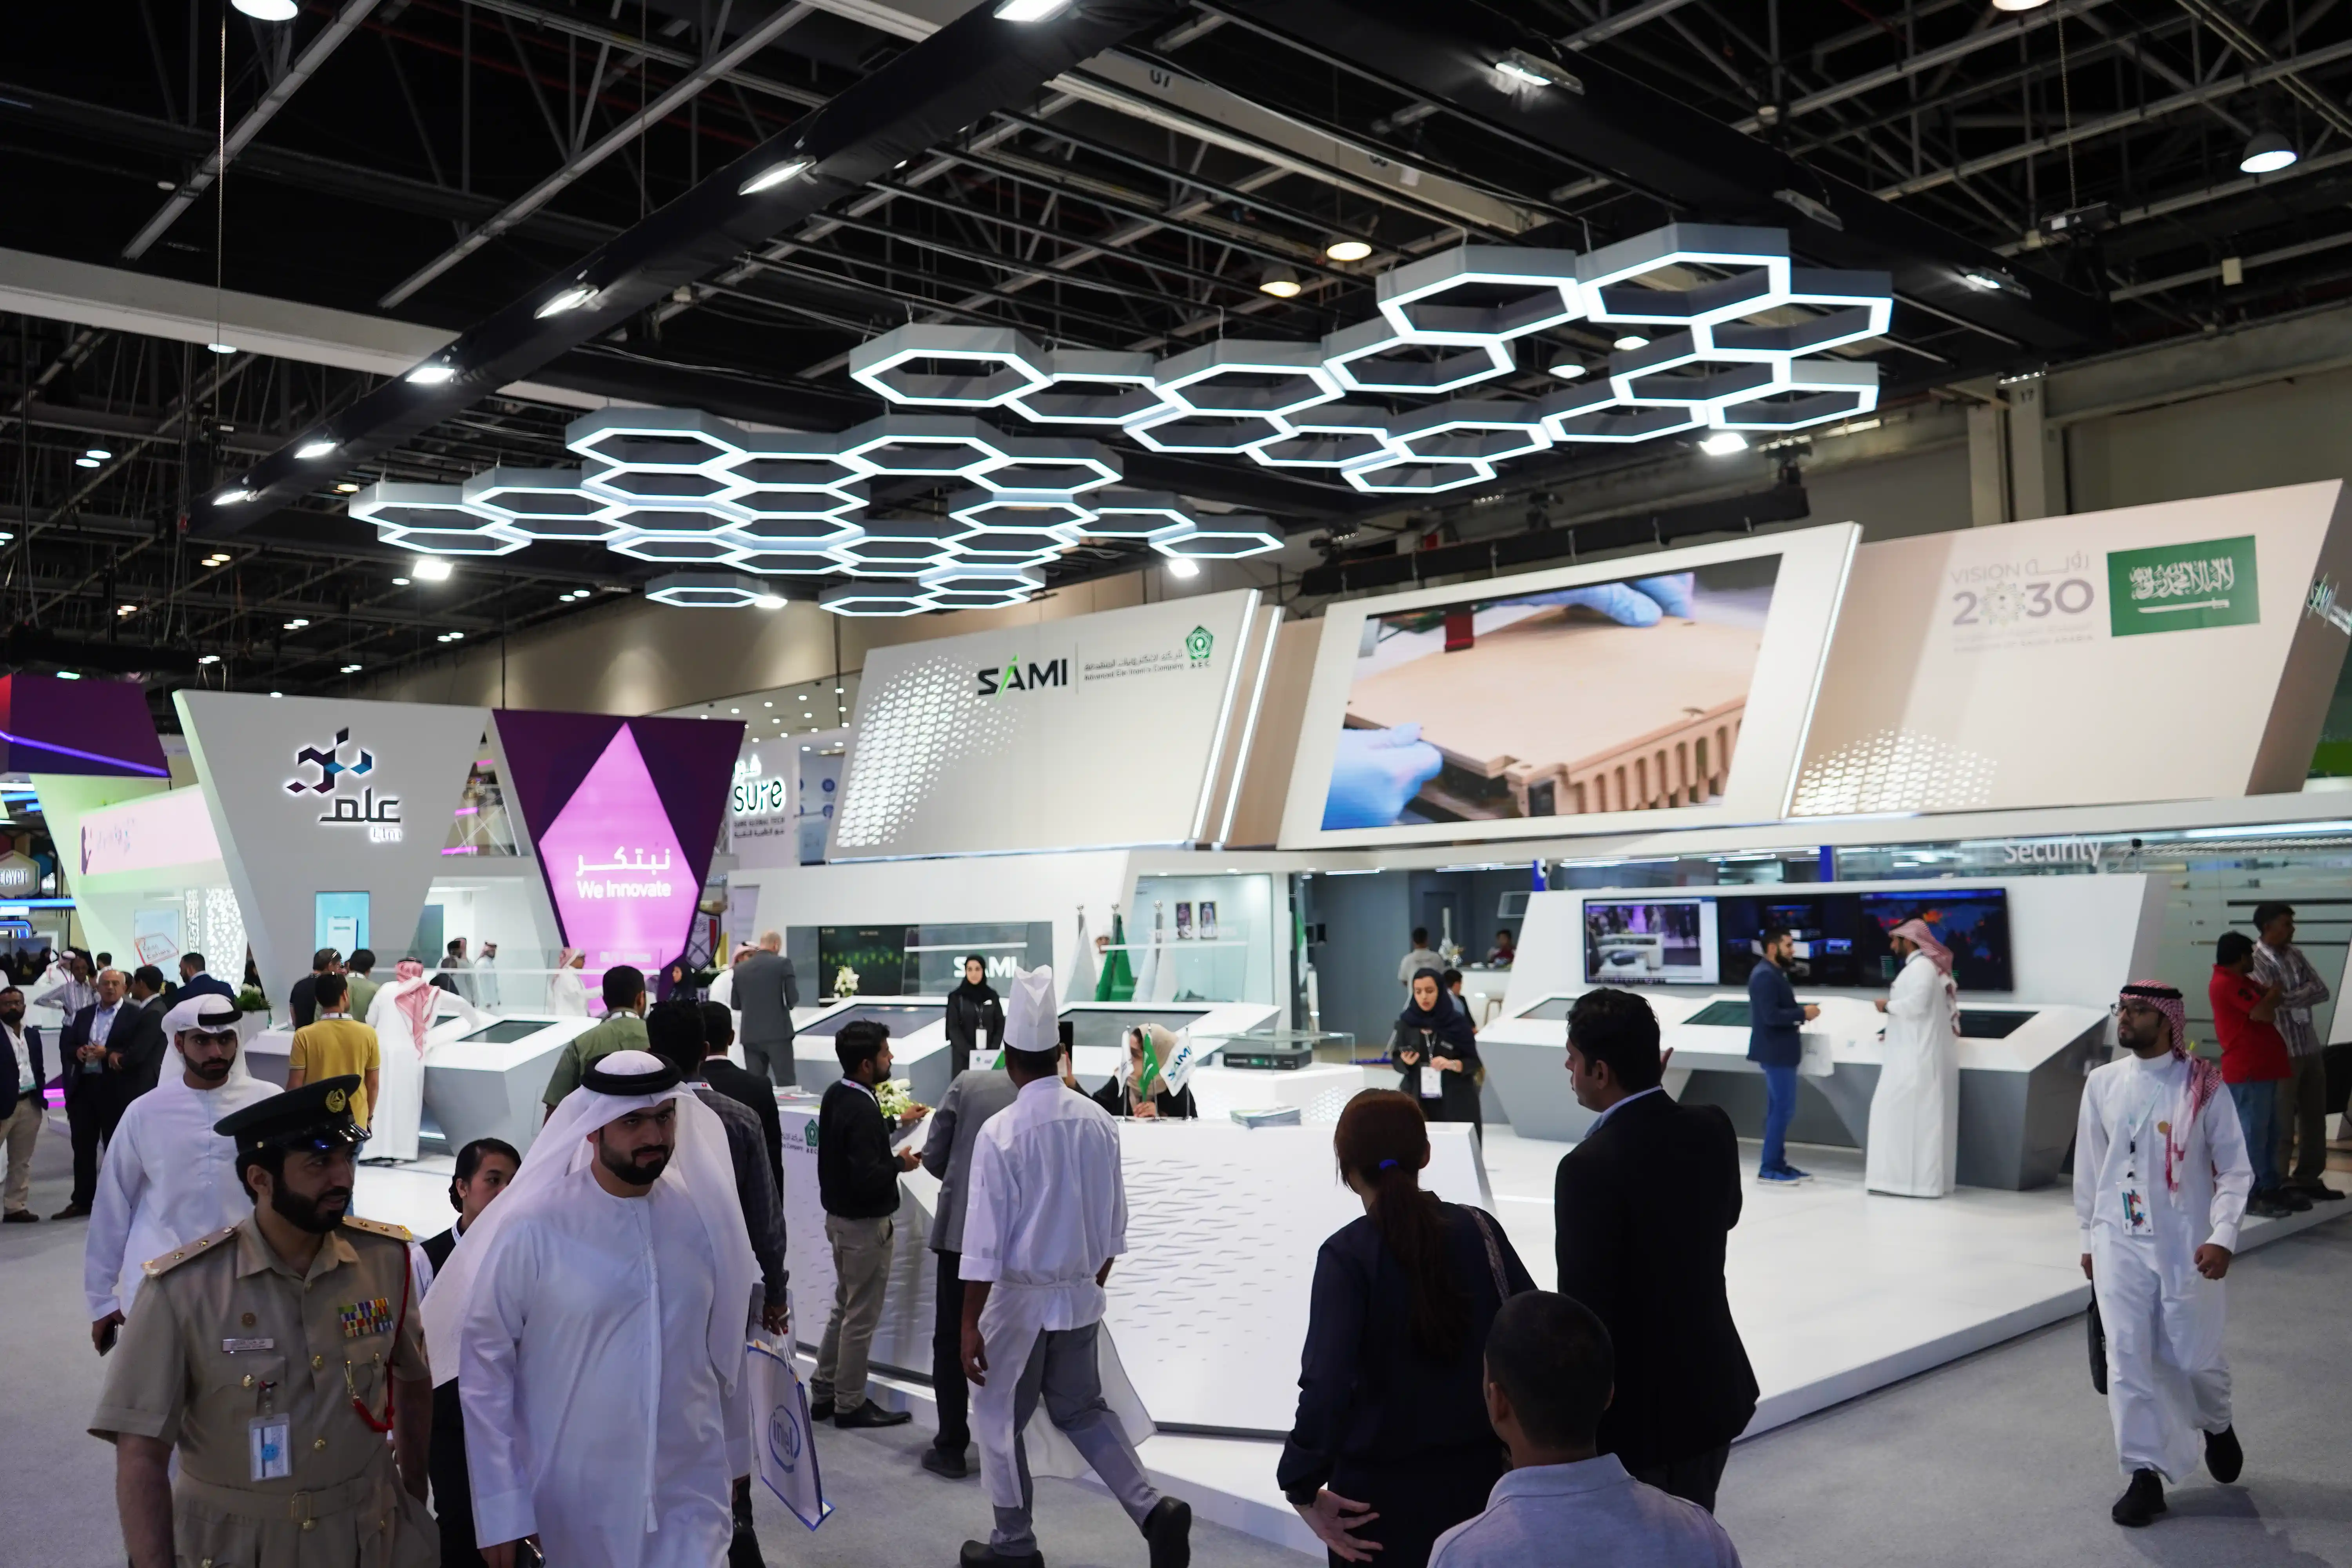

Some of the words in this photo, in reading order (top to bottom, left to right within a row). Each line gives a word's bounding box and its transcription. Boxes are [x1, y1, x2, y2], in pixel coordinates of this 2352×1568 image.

[1951, 562, 2021, 584] VISION
[978, 655, 1067, 702] SAMI
[319, 787, 401, 822] علم
[734, 780, 782, 812] sure
[2004, 835, 2102, 867] Security
[577, 880, 604, 899] We
[606, 880, 671, 898] Innovate
[953, 956, 1017, 978] SMI
[773, 1412, 793, 1458] inel
